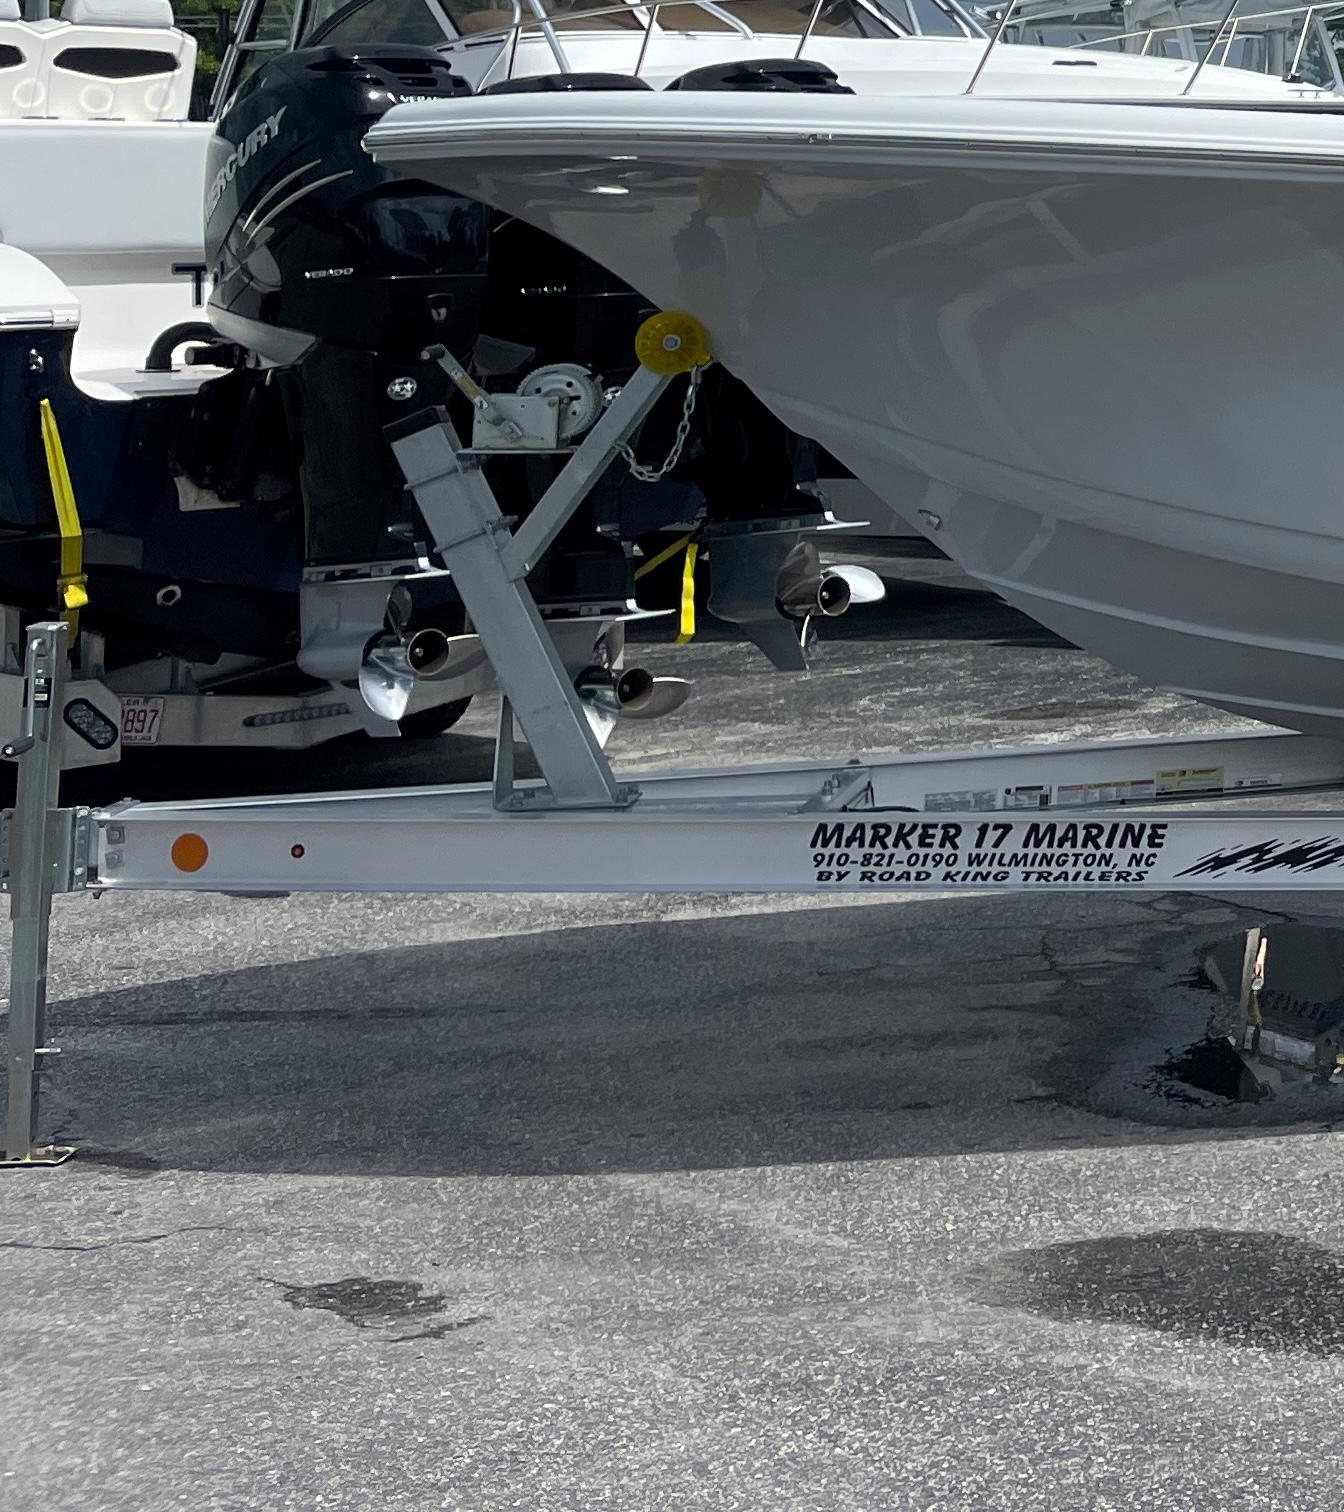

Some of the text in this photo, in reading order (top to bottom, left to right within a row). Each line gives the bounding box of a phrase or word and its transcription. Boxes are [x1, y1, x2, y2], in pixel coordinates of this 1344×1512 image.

[121, 708, 160, 734] 897
[810, 822, 1168, 851] MARKER 17 MARINE
[812, 852, 1158, 870] 910-821-0190 WILMINGTON, NC
[816, 870, 1149, 883] BY ROAD KING TRAILERS
